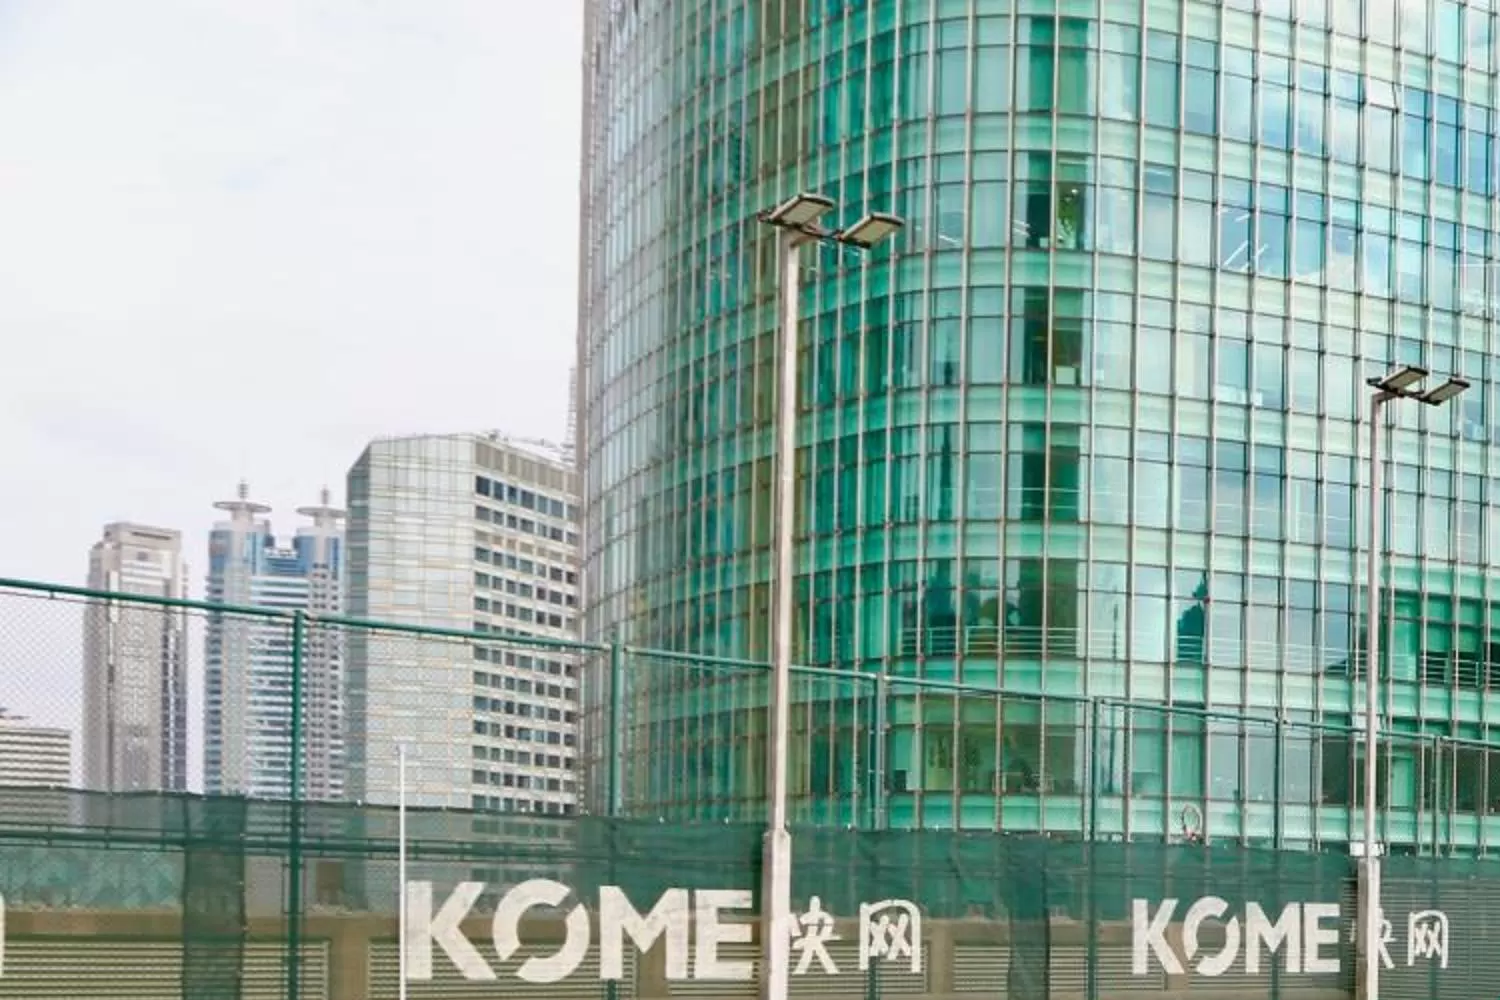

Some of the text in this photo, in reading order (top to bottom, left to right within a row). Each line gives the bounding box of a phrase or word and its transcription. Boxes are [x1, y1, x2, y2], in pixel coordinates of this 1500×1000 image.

[406, 878, 921, 982] KOME 快网
[1132, 896, 1340, 976] KOME
